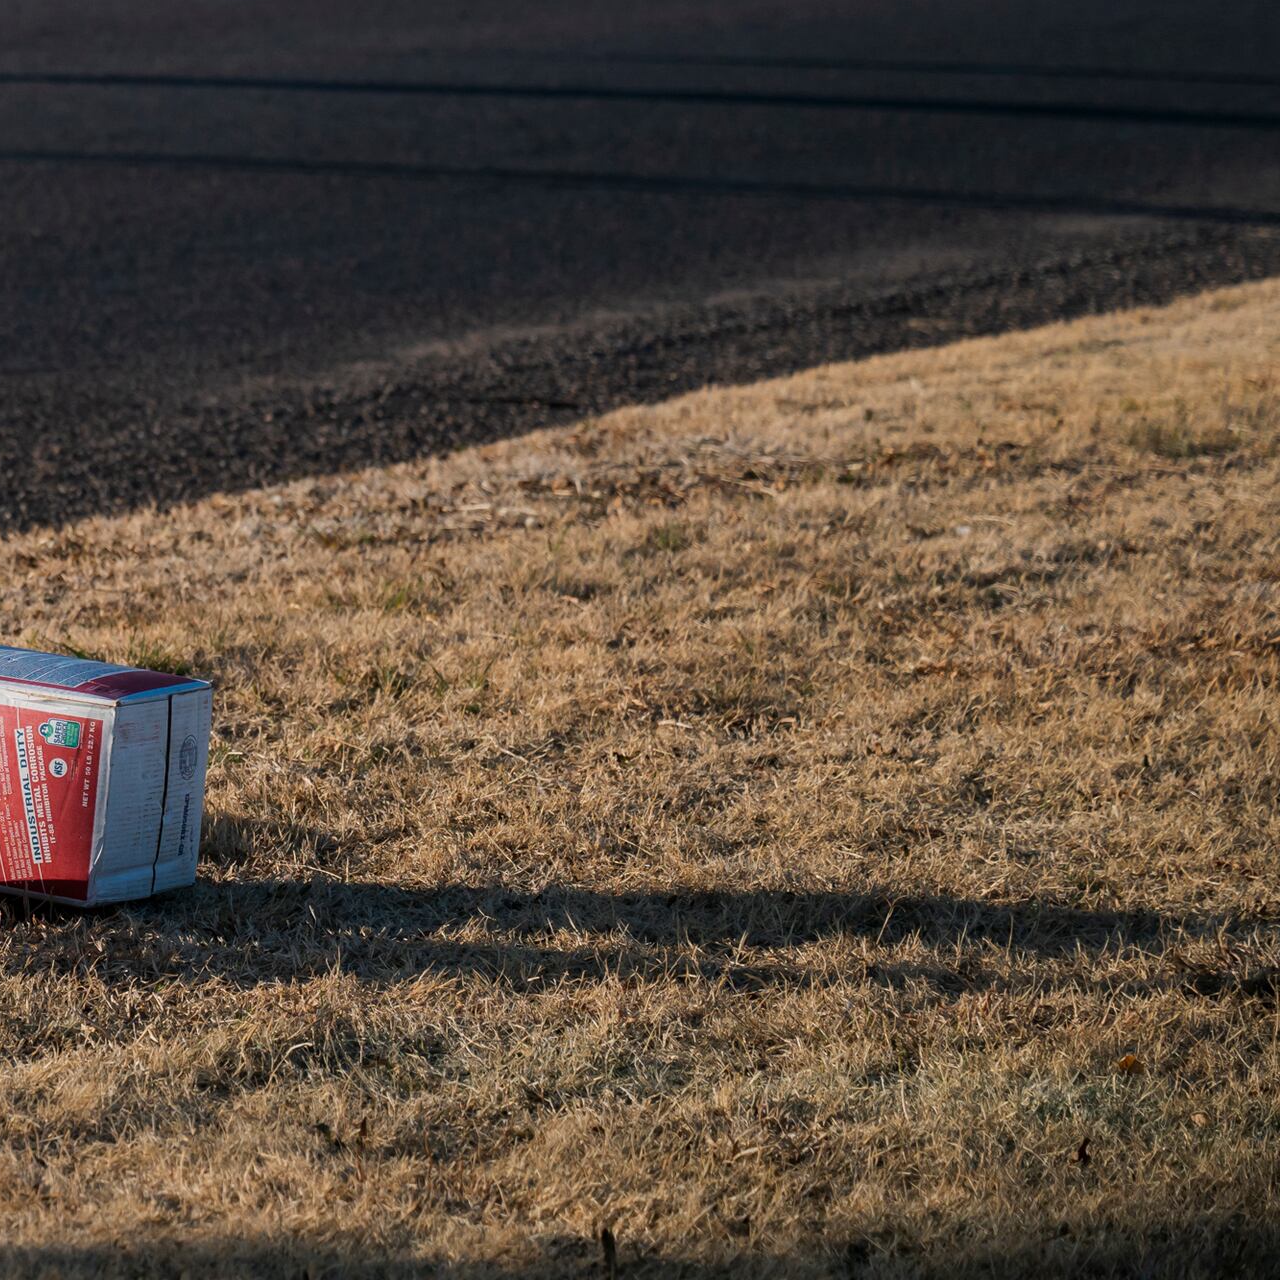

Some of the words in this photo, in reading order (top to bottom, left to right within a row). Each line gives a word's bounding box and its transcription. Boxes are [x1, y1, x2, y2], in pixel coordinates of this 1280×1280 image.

[16, 730, 27, 769] DUTY
[53, 721, 62, 744] SAFER
[25, 725, 39, 783] CORROSION
[36, 745, 47, 781] PACKAGE
[54, 760, 64, 775] NSF
[81, 791, 89, 807] NET
[83, 778, 90, 790] WT
[23, 773, 41, 861] INDUSTRIAL
[33, 785, 45, 818] METAL
[42, 783, 53, 822] INHIBITOR
[38, 821, 52, 863] INHIBITS
[47, 823, 56, 844] IT-88
